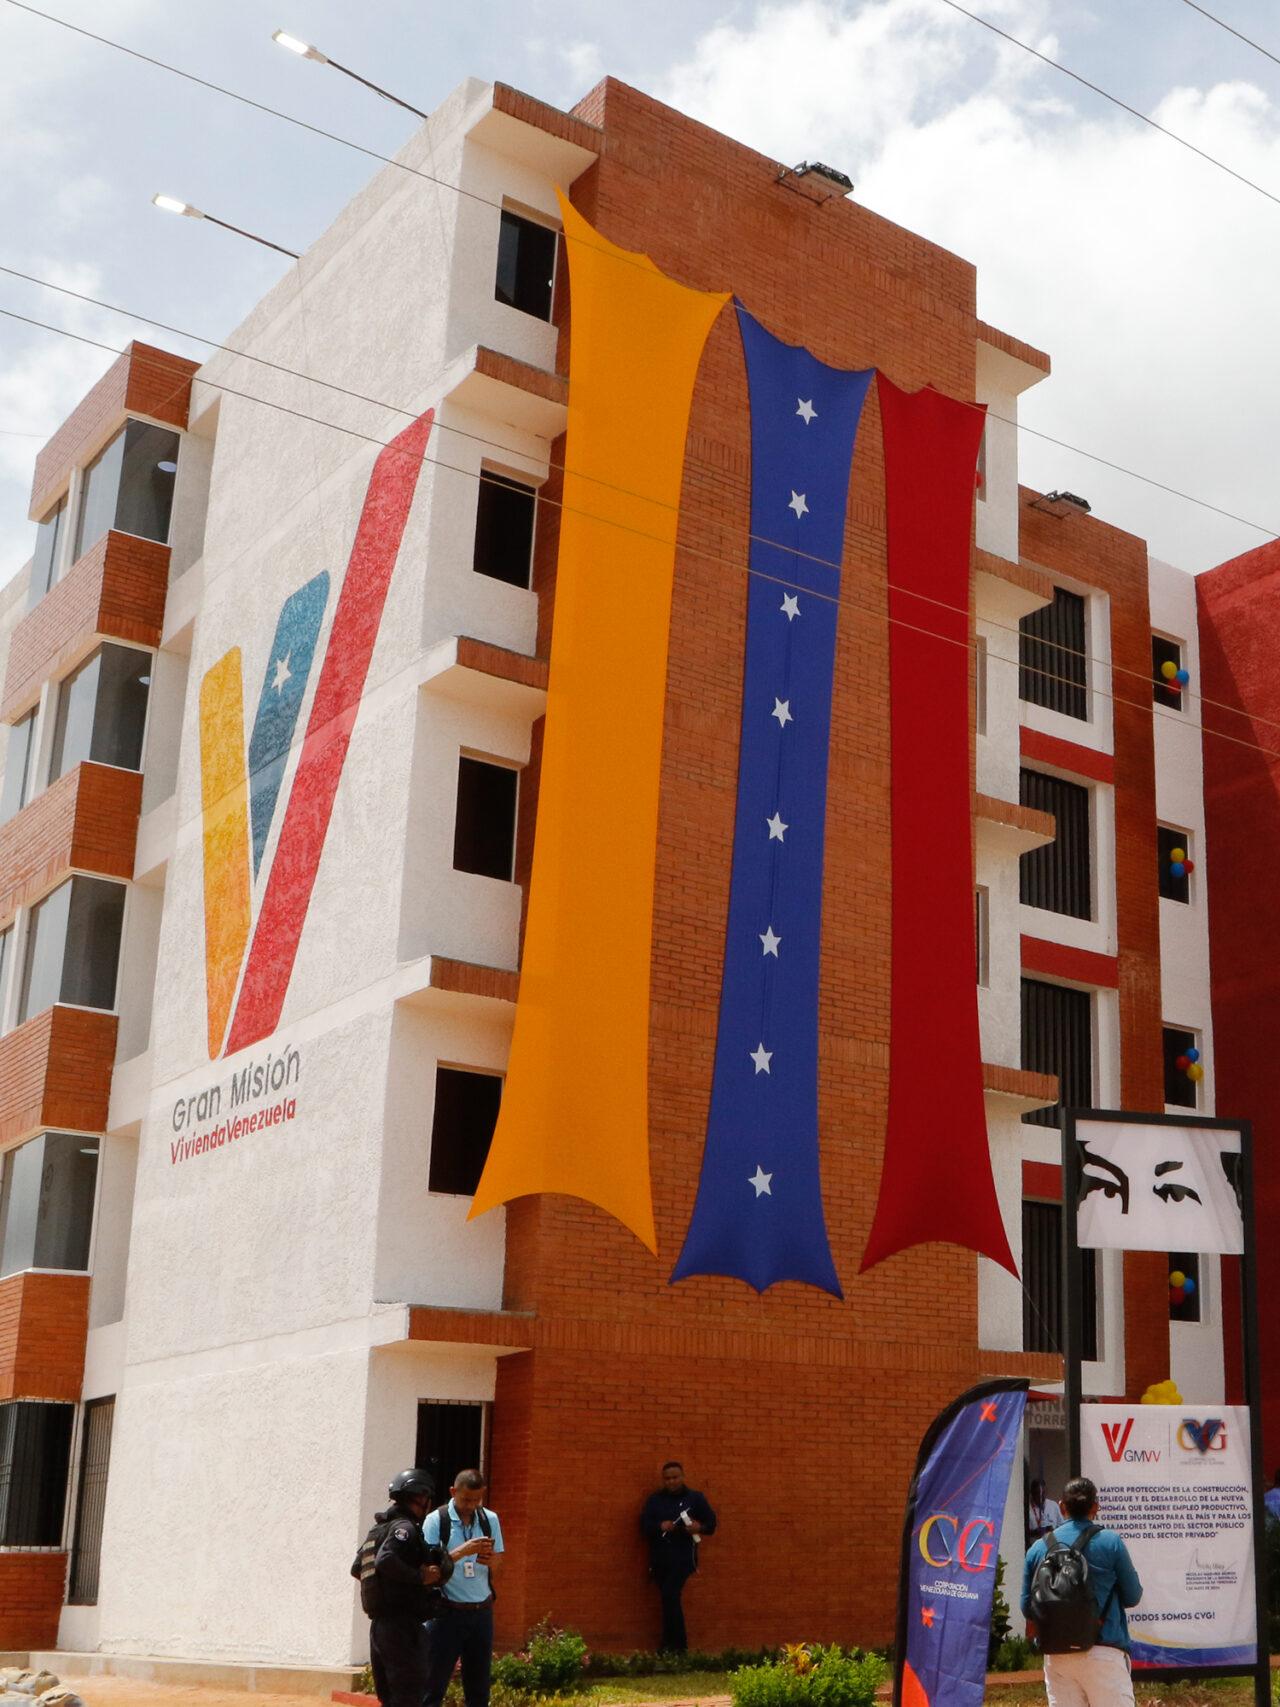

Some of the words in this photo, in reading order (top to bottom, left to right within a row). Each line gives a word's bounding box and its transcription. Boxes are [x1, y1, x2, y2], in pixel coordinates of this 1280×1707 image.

[172, 1085, 222, 1132] Gran
[230, 1044, 300, 1109] Misión
[170, 1123, 225, 1165] Vivienda
[226, 1097, 296, 1142] Venezuela
[1123, 1450, 1161, 1463] GMVV
[1126, 1484, 1171, 1493] PROTECCIÓN
[1192, 1483, 1249, 1493] CONSTRUCCIÓN,
[1195, 1512, 1210, 1520] PAÍS
[1215, 1521, 1245, 1529] PÚBLICO
[1127, 1613, 1159, 1623] ¡TODOS
[1160, 1612, 1192, 1621] SOMOS
[1194, 1611, 1215, 1620] CVG!
